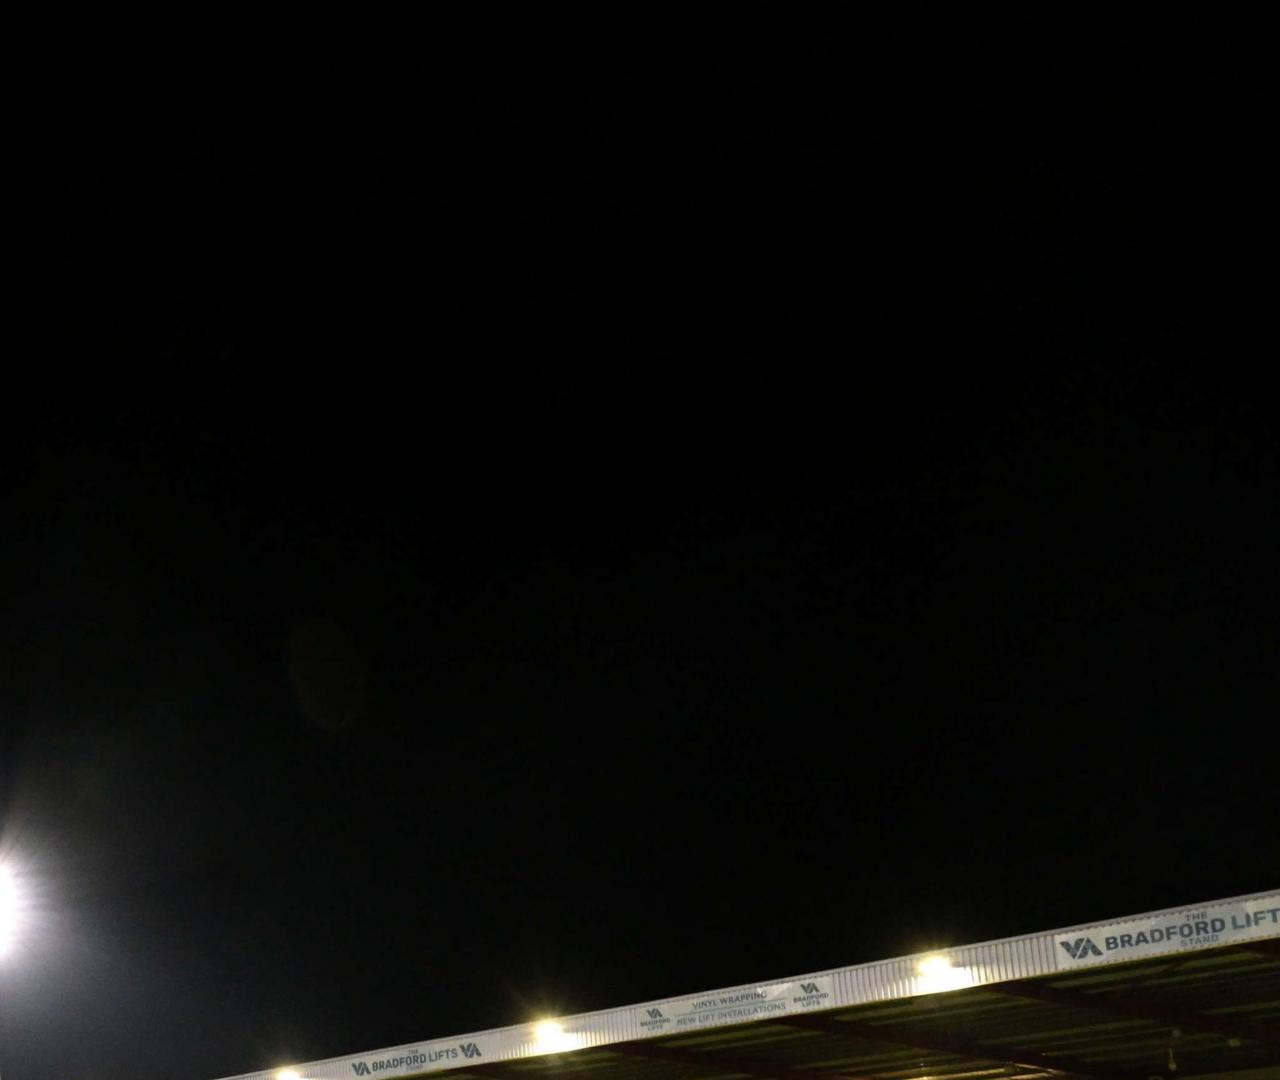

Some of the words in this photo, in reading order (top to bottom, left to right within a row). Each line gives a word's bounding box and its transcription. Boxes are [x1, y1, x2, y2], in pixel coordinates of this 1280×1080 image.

[1187, 912, 1207, 921] THE
[1105, 918, 1225, 950] BRADFORD
[1180, 934, 1218, 947] STAND
[693, 1000, 717, 1010] VINYL
[720, 992, 767, 1006] WRAPPING
[793, 993, 829, 1003] BRADFORD
[677, 1016, 695, 1026] NEW
[698, 1014, 715, 1024] LIFT
[718, 1003, 786, 1020] INSTALLATIONS
[372, 1053, 426, 1072] BRADFORD
[429, 1048, 458, 1063] LIFTS
